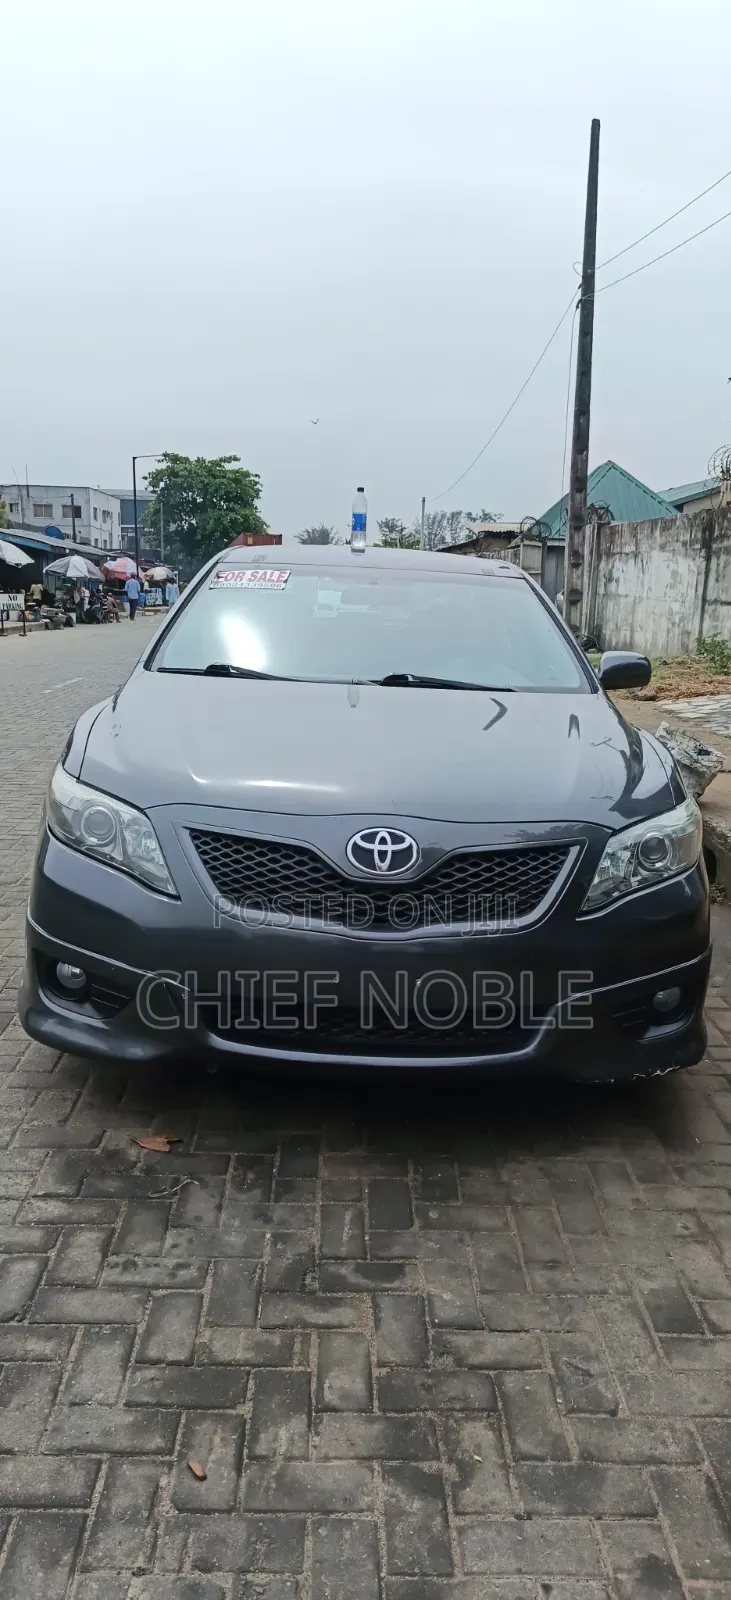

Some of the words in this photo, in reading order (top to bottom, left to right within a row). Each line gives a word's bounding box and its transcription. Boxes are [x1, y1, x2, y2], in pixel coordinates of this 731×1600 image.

[216, 571, 246, 582] FOR
[248, 571, 288, 583] SALE
[2, 602, 24, 611] PARKING
